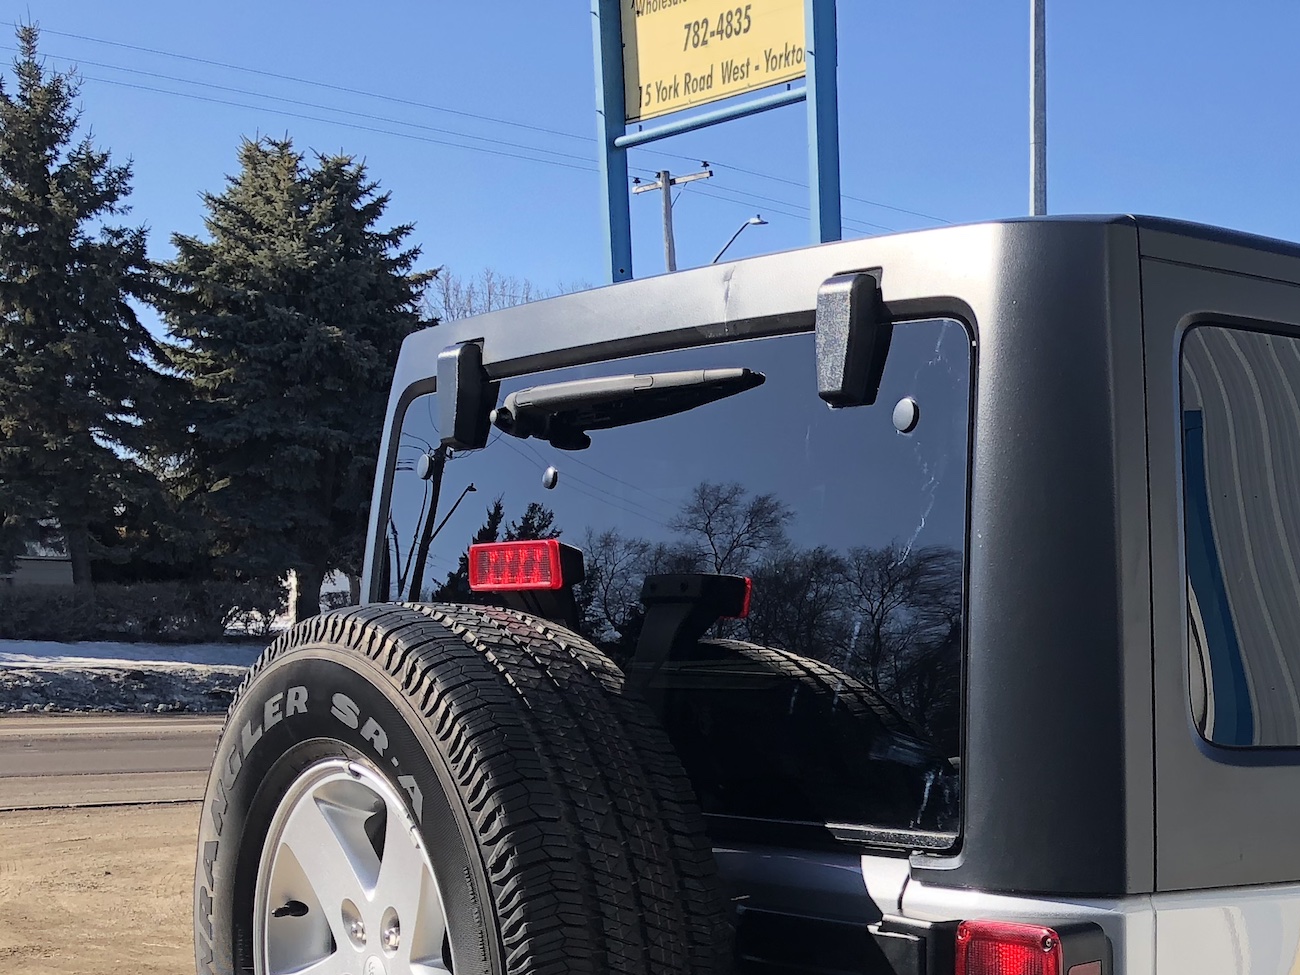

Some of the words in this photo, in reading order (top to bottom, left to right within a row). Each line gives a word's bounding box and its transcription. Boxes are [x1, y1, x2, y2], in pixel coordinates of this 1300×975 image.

[683, 4, 752, 52] 782-4835
[655, 74, 680, 104] York
[683, 63, 714, 96] Road
[721, 57, 751, 85] West
[763, 42, 806, 73] Yorkto
